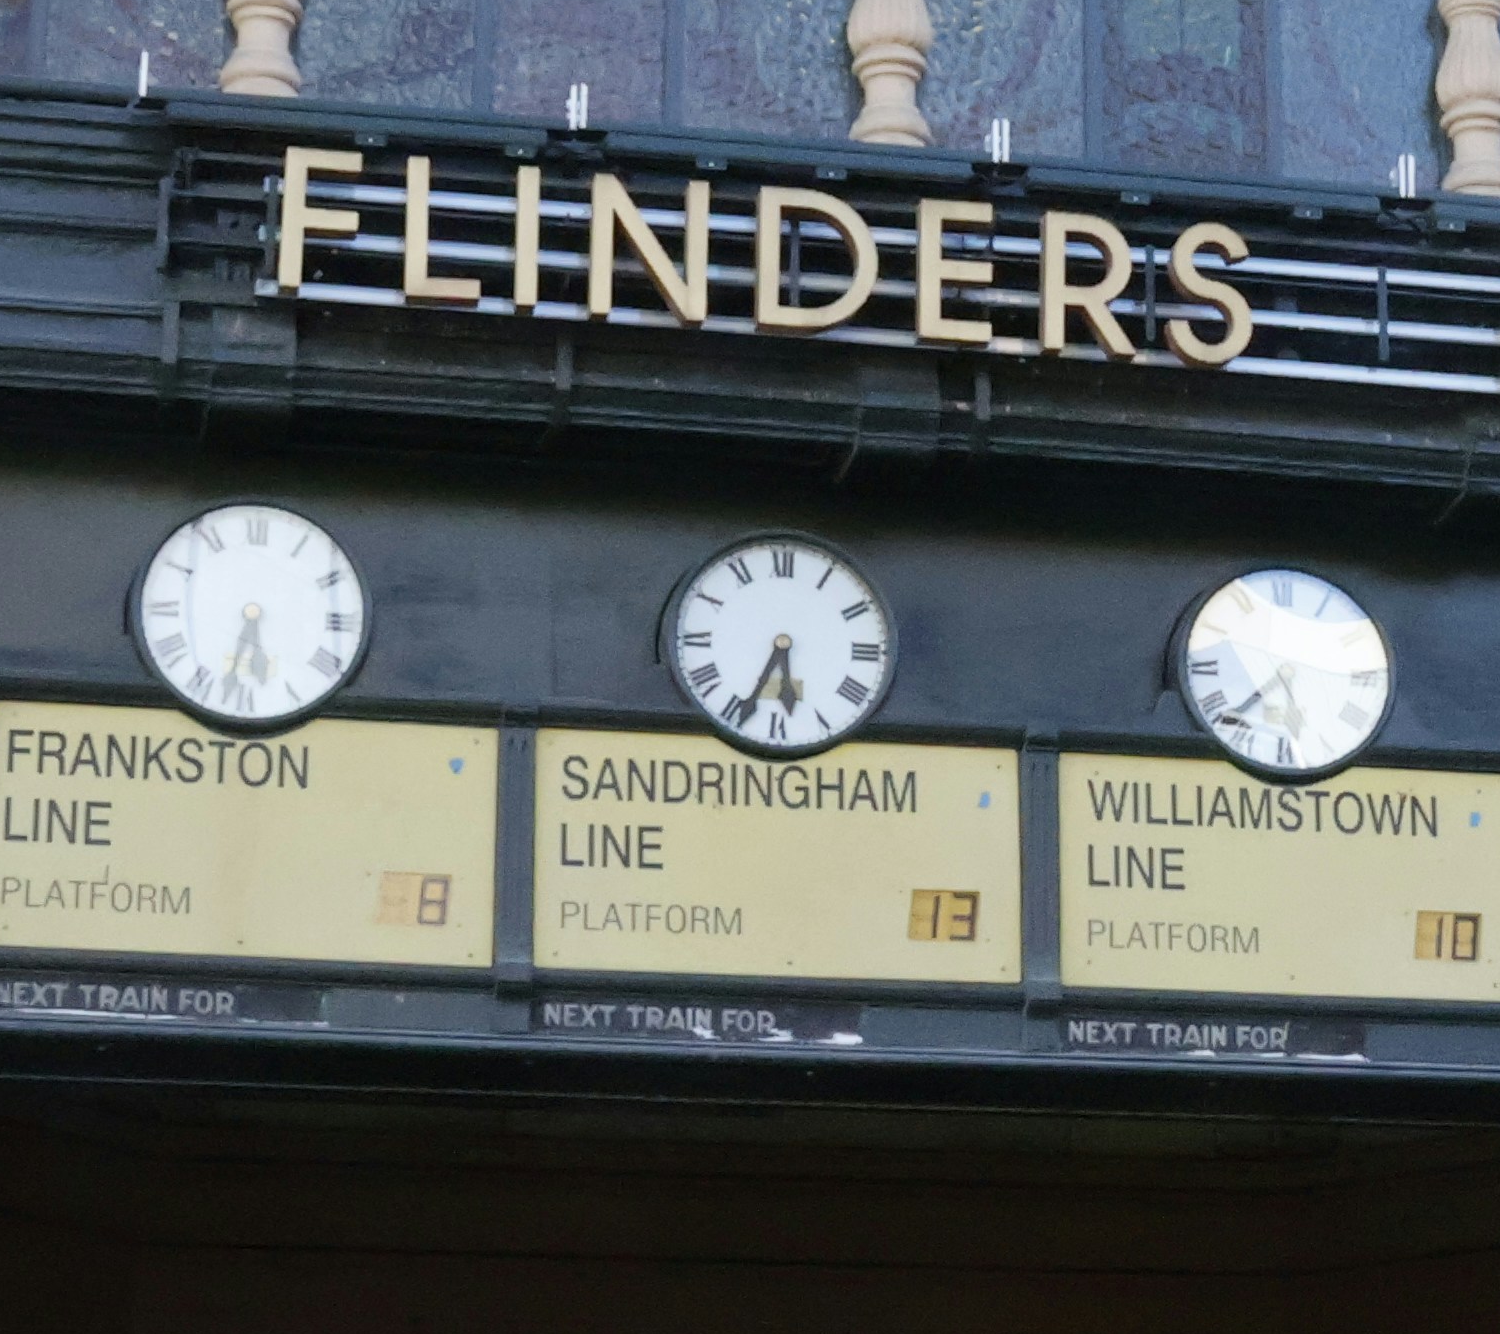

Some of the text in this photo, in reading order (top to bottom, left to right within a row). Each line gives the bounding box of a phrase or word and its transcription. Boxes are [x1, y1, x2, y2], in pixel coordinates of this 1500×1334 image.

[276, 147, 1253, 366] FLINDERS
[6, 729, 310, 789] FRANKSTON
[561, 755, 918, 813] SANDRINGHAM
[2, 796, 113, 846] LINE
[1088, 779, 1438, 837] WILLIAMSTOWN
[560, 822, 664, 869] LINE
[1087, 843, 1186, 890] LINE
[0, 876, 192, 915] PLATFORM
[560, 891, 978, 942] PLATFORM 13
[1087, 914, 1479, 961] PLATFORM 10
[81, 983, 168, 1013] TRAIN
[179, 988, 236, 1016] FOR
[543, 1002, 777, 1034] NEXT TRAIN FOR
[1068, 1020, 1286, 1050] NEXT TRAIN FOR
